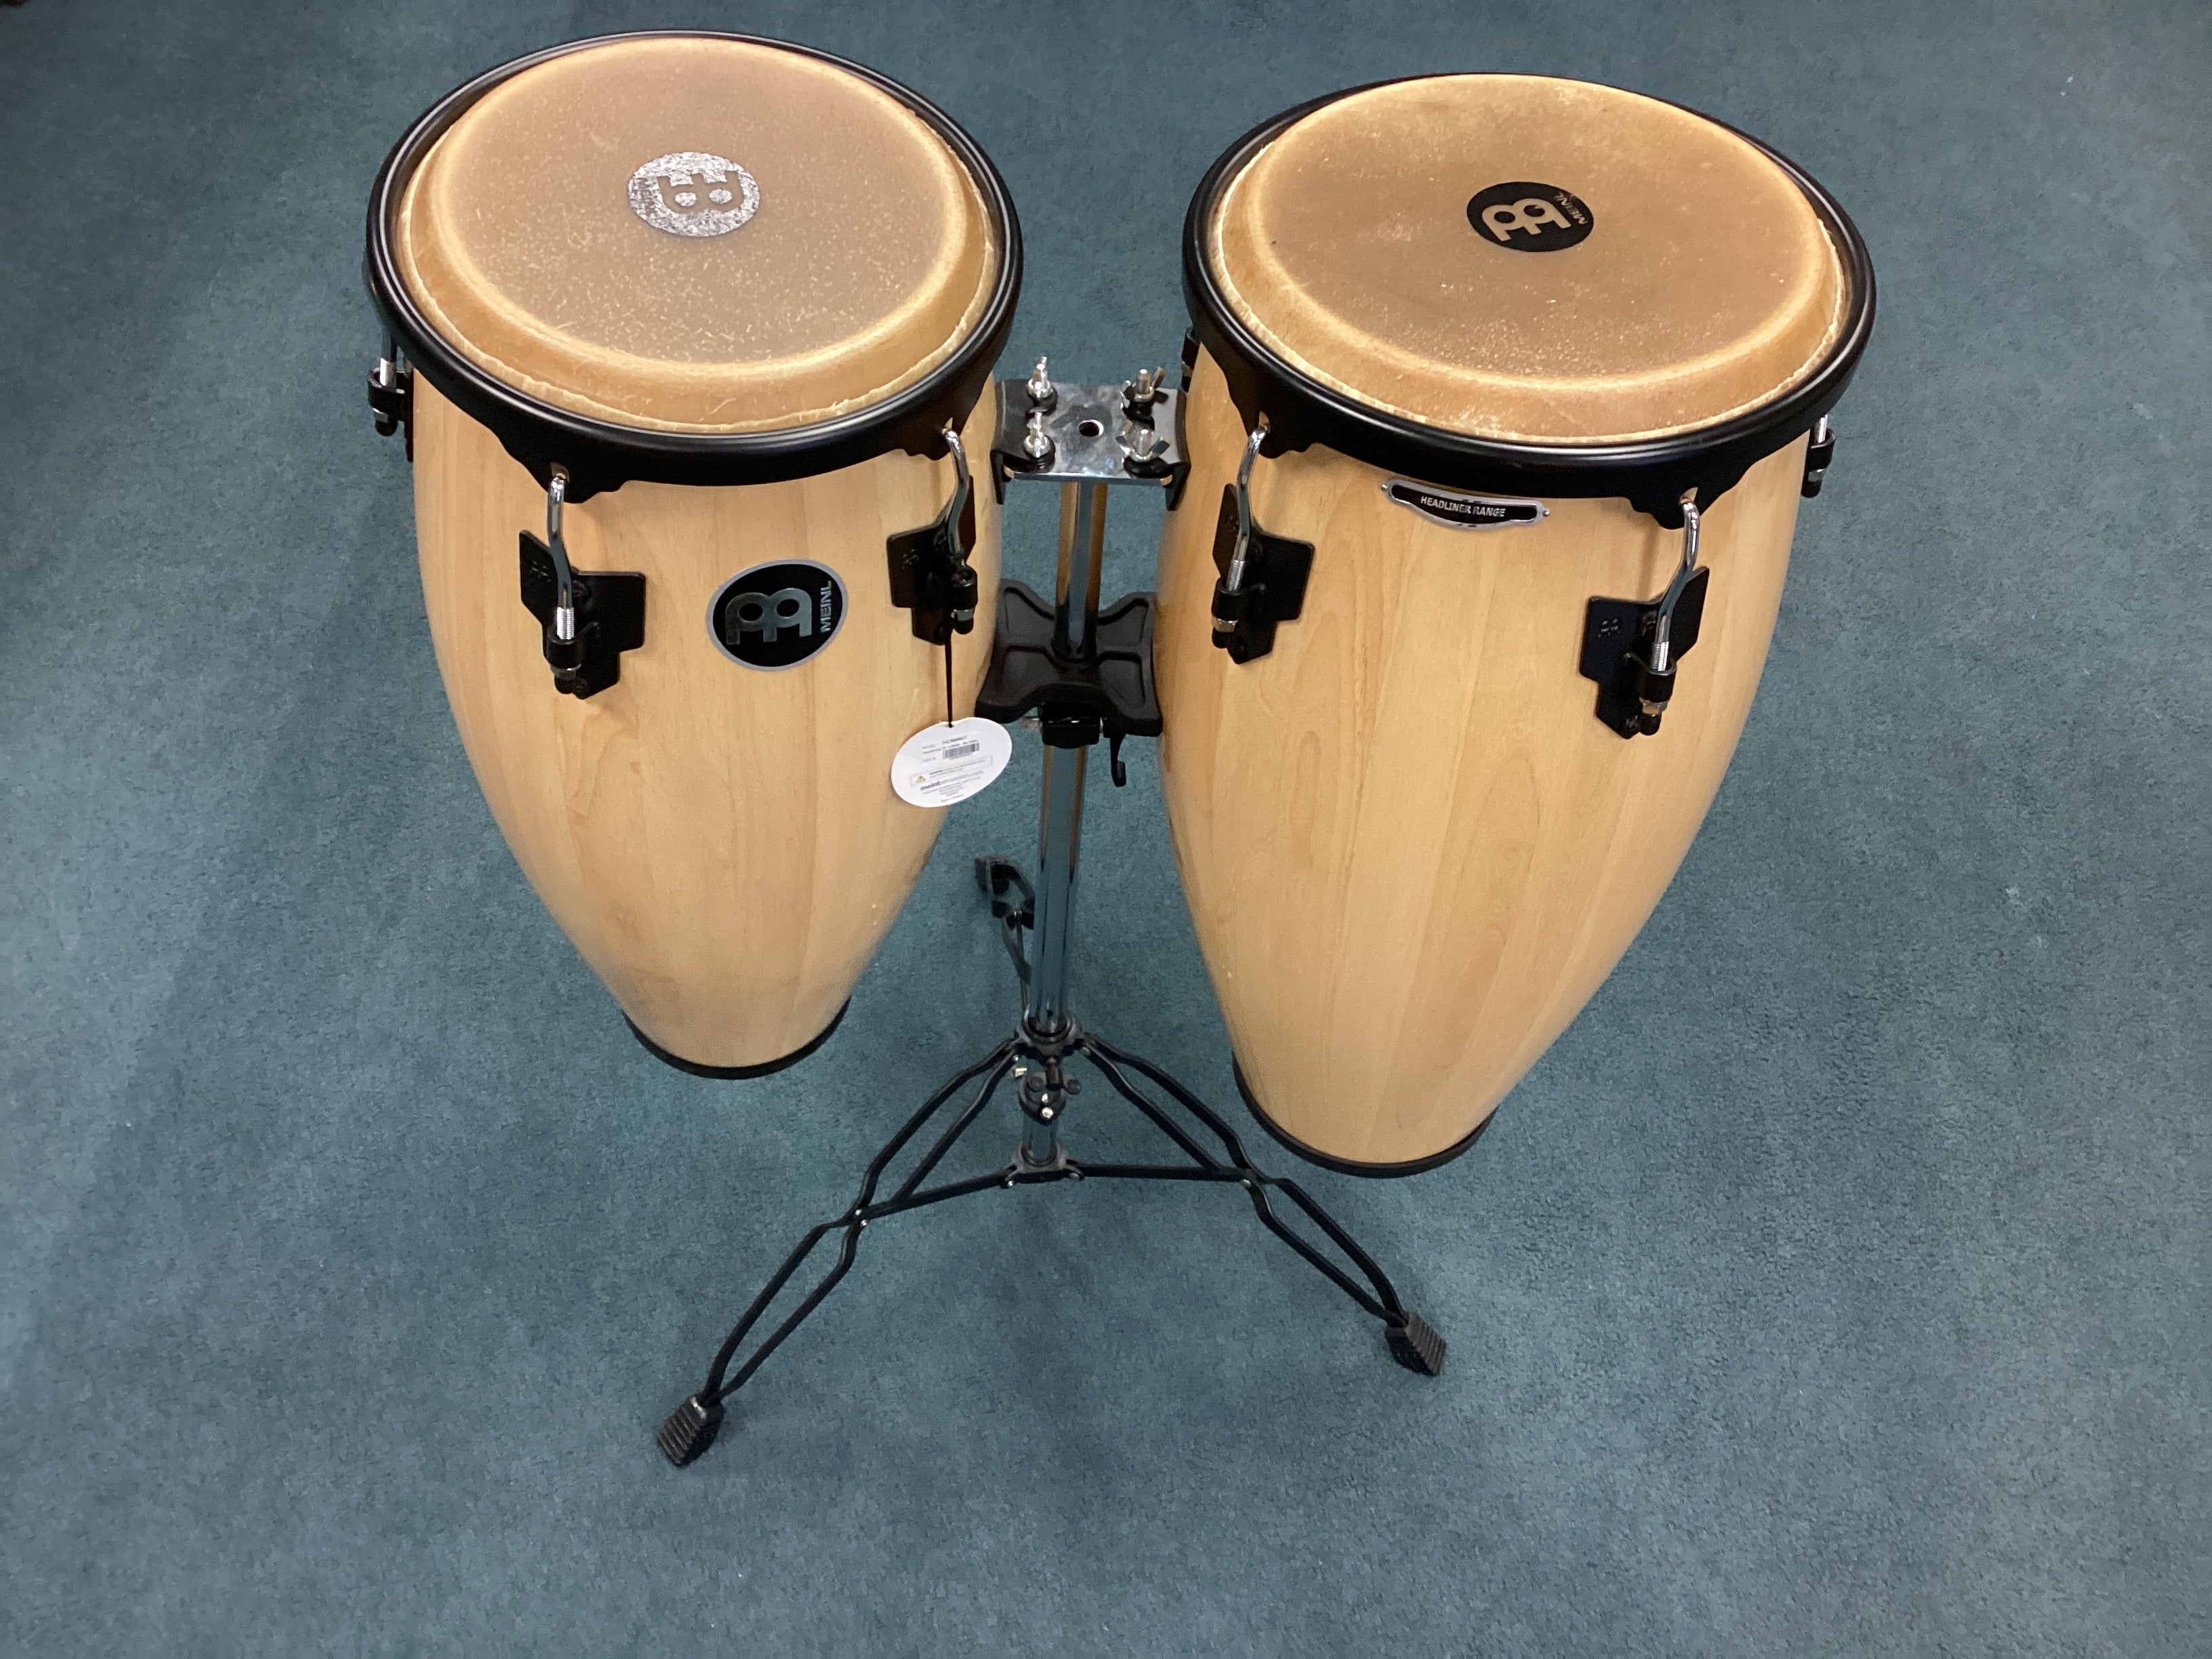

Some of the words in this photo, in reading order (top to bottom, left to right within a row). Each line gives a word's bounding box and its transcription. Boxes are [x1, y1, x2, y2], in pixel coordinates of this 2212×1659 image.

[1554, 191, 1589, 224] MEINL
[1420, 495, 1471, 514] HEADLINER
[1472, 506, 1506, 517] RANGE
[820, 580, 832, 633] MEINL
